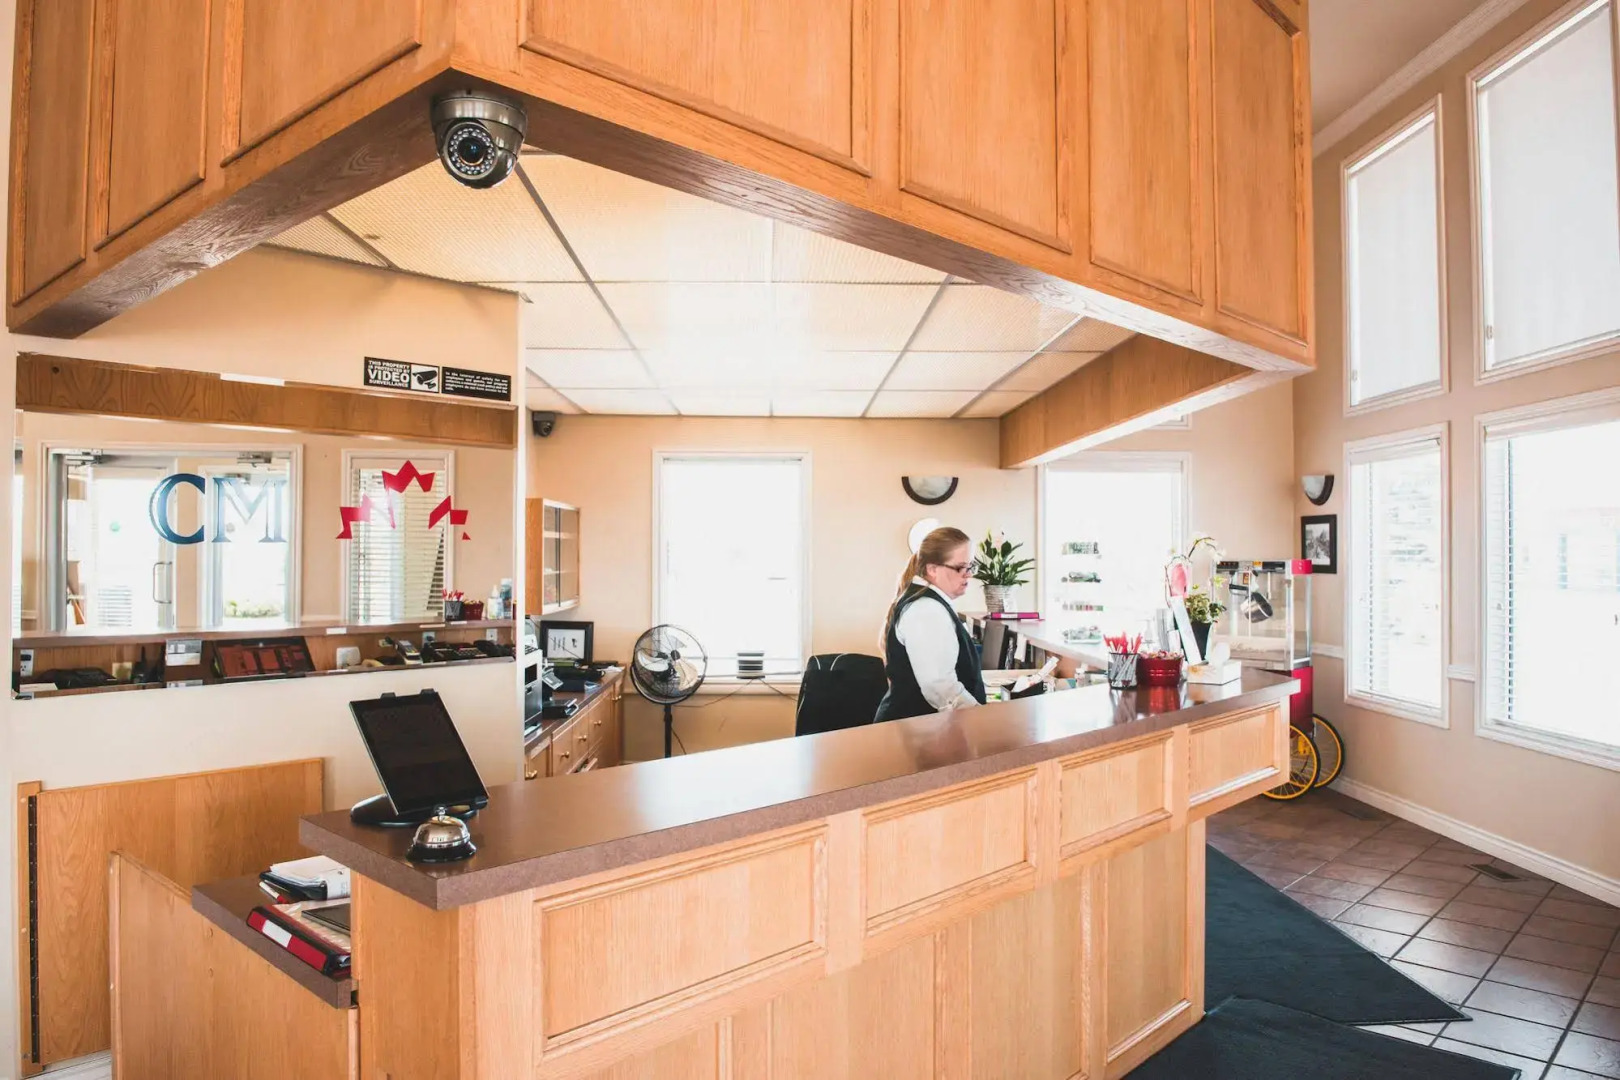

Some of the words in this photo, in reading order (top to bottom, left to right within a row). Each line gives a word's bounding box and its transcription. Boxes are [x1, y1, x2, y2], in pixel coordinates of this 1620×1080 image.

[368, 369, 410, 383] VIDEO
[369, 379, 409, 388] SURVEILLANCE
[149, 473, 287, 544] CM
